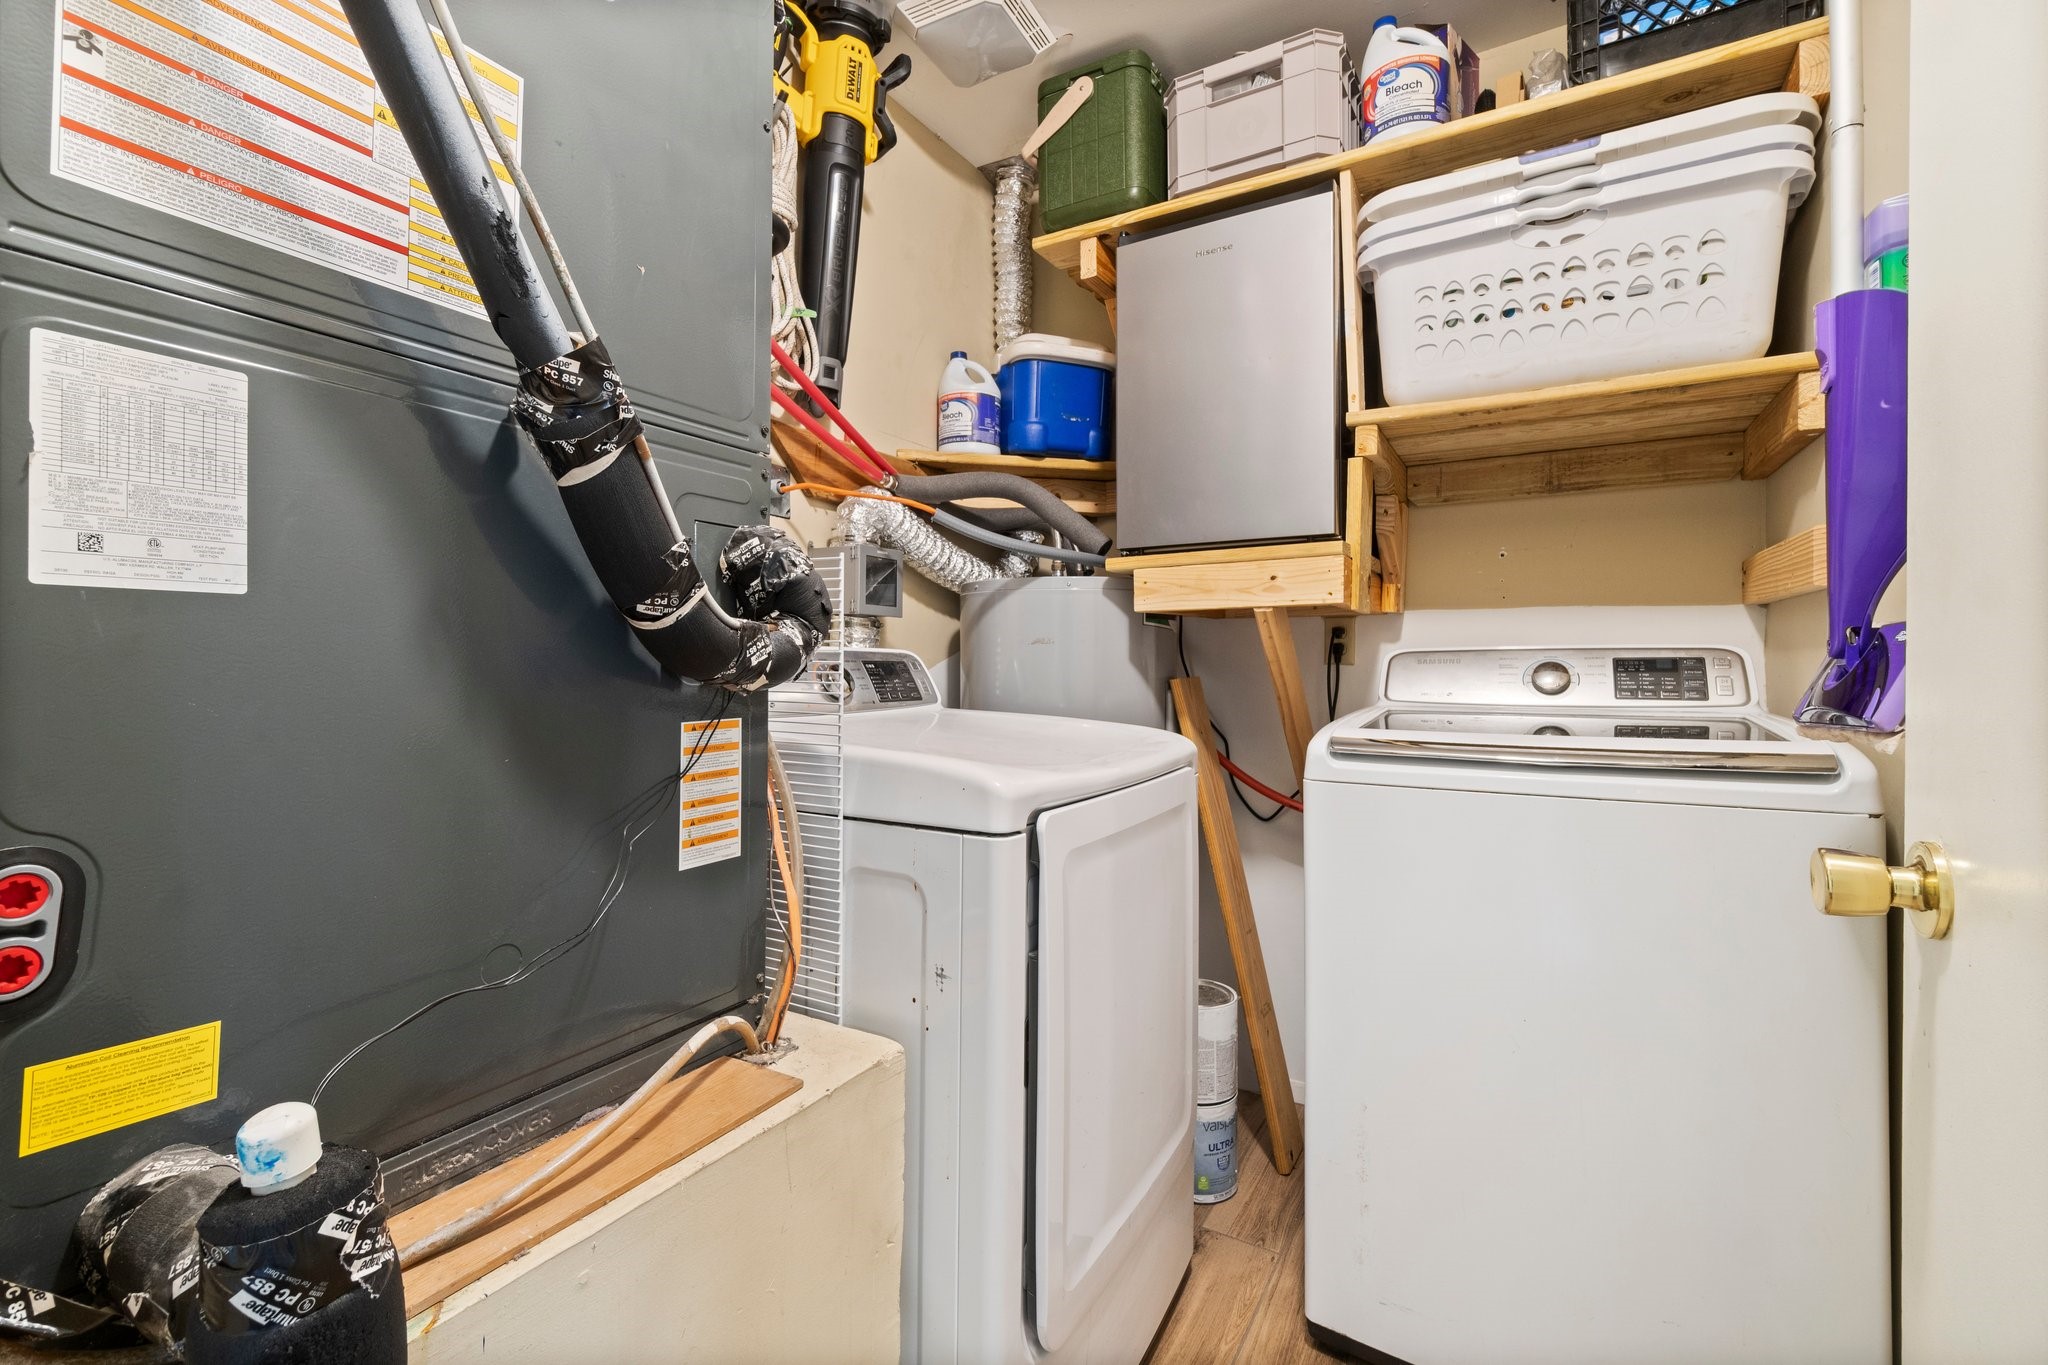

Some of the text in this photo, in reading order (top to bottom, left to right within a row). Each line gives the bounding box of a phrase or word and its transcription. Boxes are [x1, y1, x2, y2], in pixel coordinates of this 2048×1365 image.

[204, 40, 282, 81] AVERTISSEMENT
[106, 39, 278, 123] CARBON MONOXIDE POISONING HAZARD
[203, 75, 244, 99] DANGER
[1385, 80, 1423, 97] Bleach
[63, 75, 101, 97] RISQUE
[273, 160, 309, 180] CARBONE
[201, 123, 242, 146] DANGER
[63, 129, 101, 148] RIESGO
[104, 144, 117, 154] DE
[186, 174, 204, 186] POR
[265, 203, 302, 222] CARBONO
[200, 172, 243, 193] PELIGRO
[1195, 243, 1233, 258] Hisense
[544, 366, 584, 387] PC 857
[942, 411, 963, 421] Bleach
[482, 1108, 553, 1153] COVER
[1208, 1137, 1235, 1152] ULTRA
[168, 1254, 194, 1280] 857
[241, 1275, 303, 1306] PC 857
